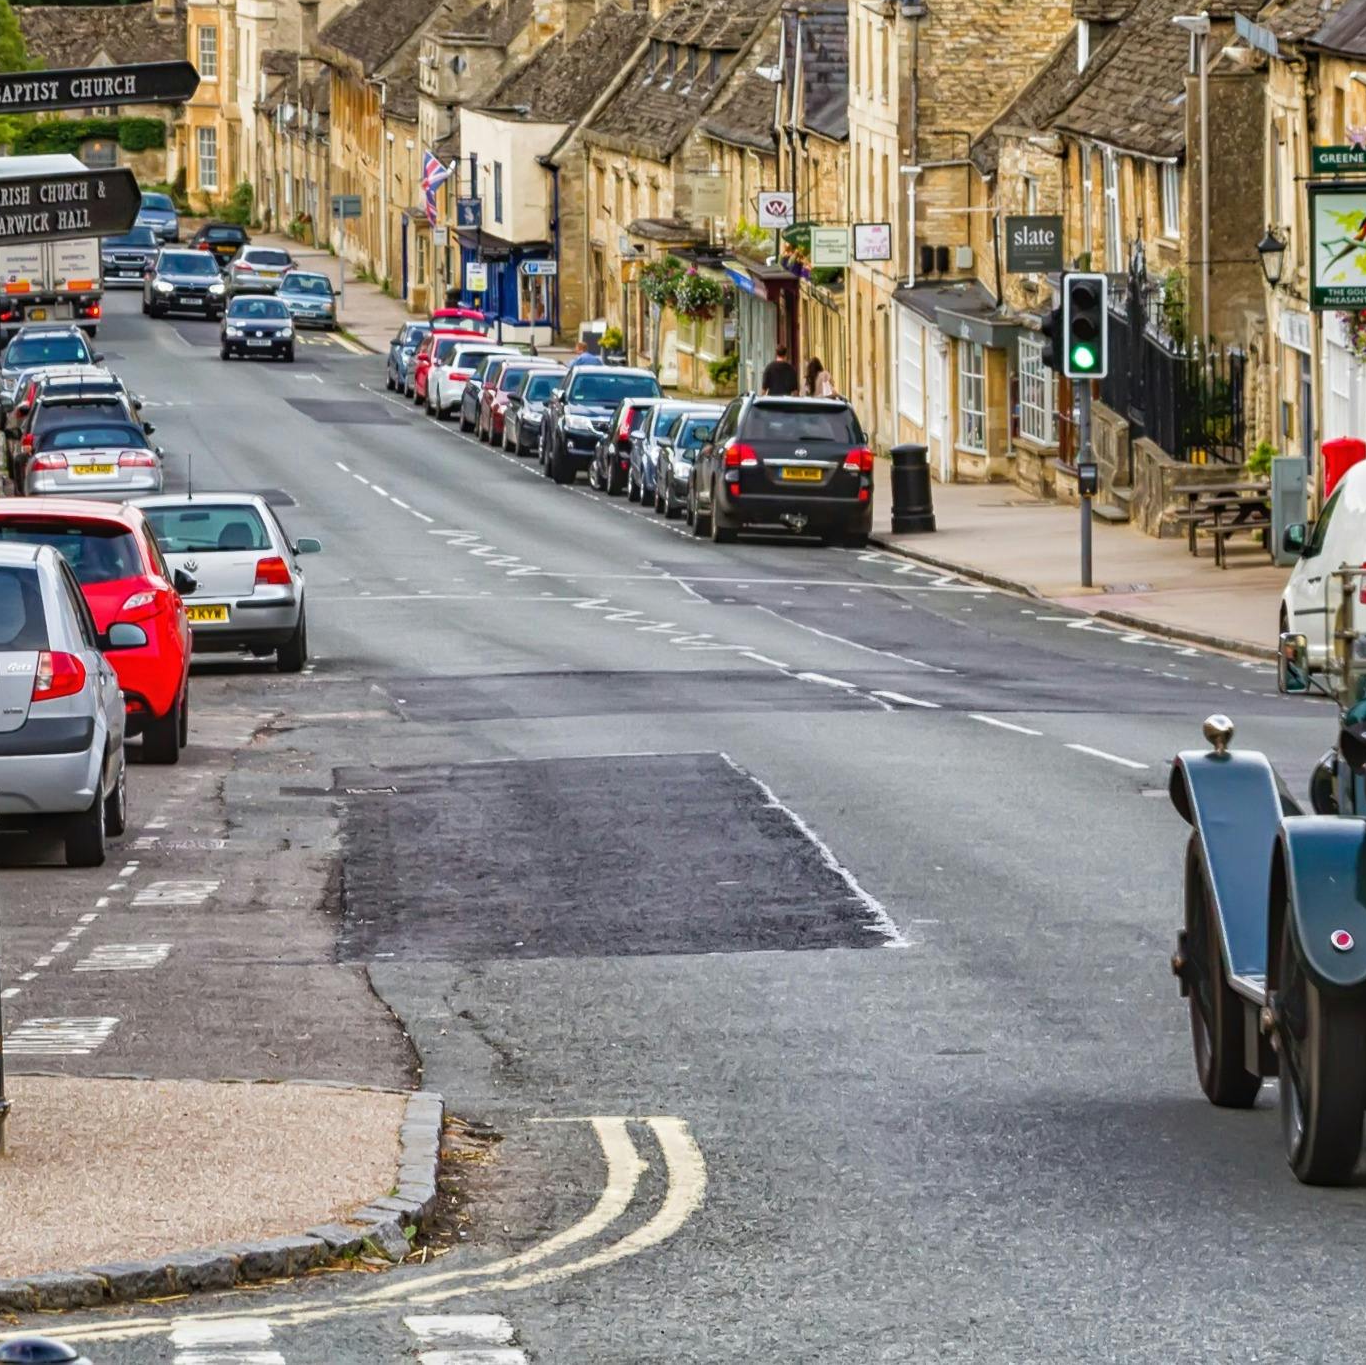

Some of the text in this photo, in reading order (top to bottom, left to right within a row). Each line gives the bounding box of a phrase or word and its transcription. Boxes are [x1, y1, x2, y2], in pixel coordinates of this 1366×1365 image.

[70, 75, 136, 98] CHURCH
[1319, 153, 1364, 163] GREENE
[40, 182, 88, 203] CHURCH
[97, 180, 106, 198] &
[58, 209, 91, 230] HALL
[1014, 225, 1055, 245] slate
